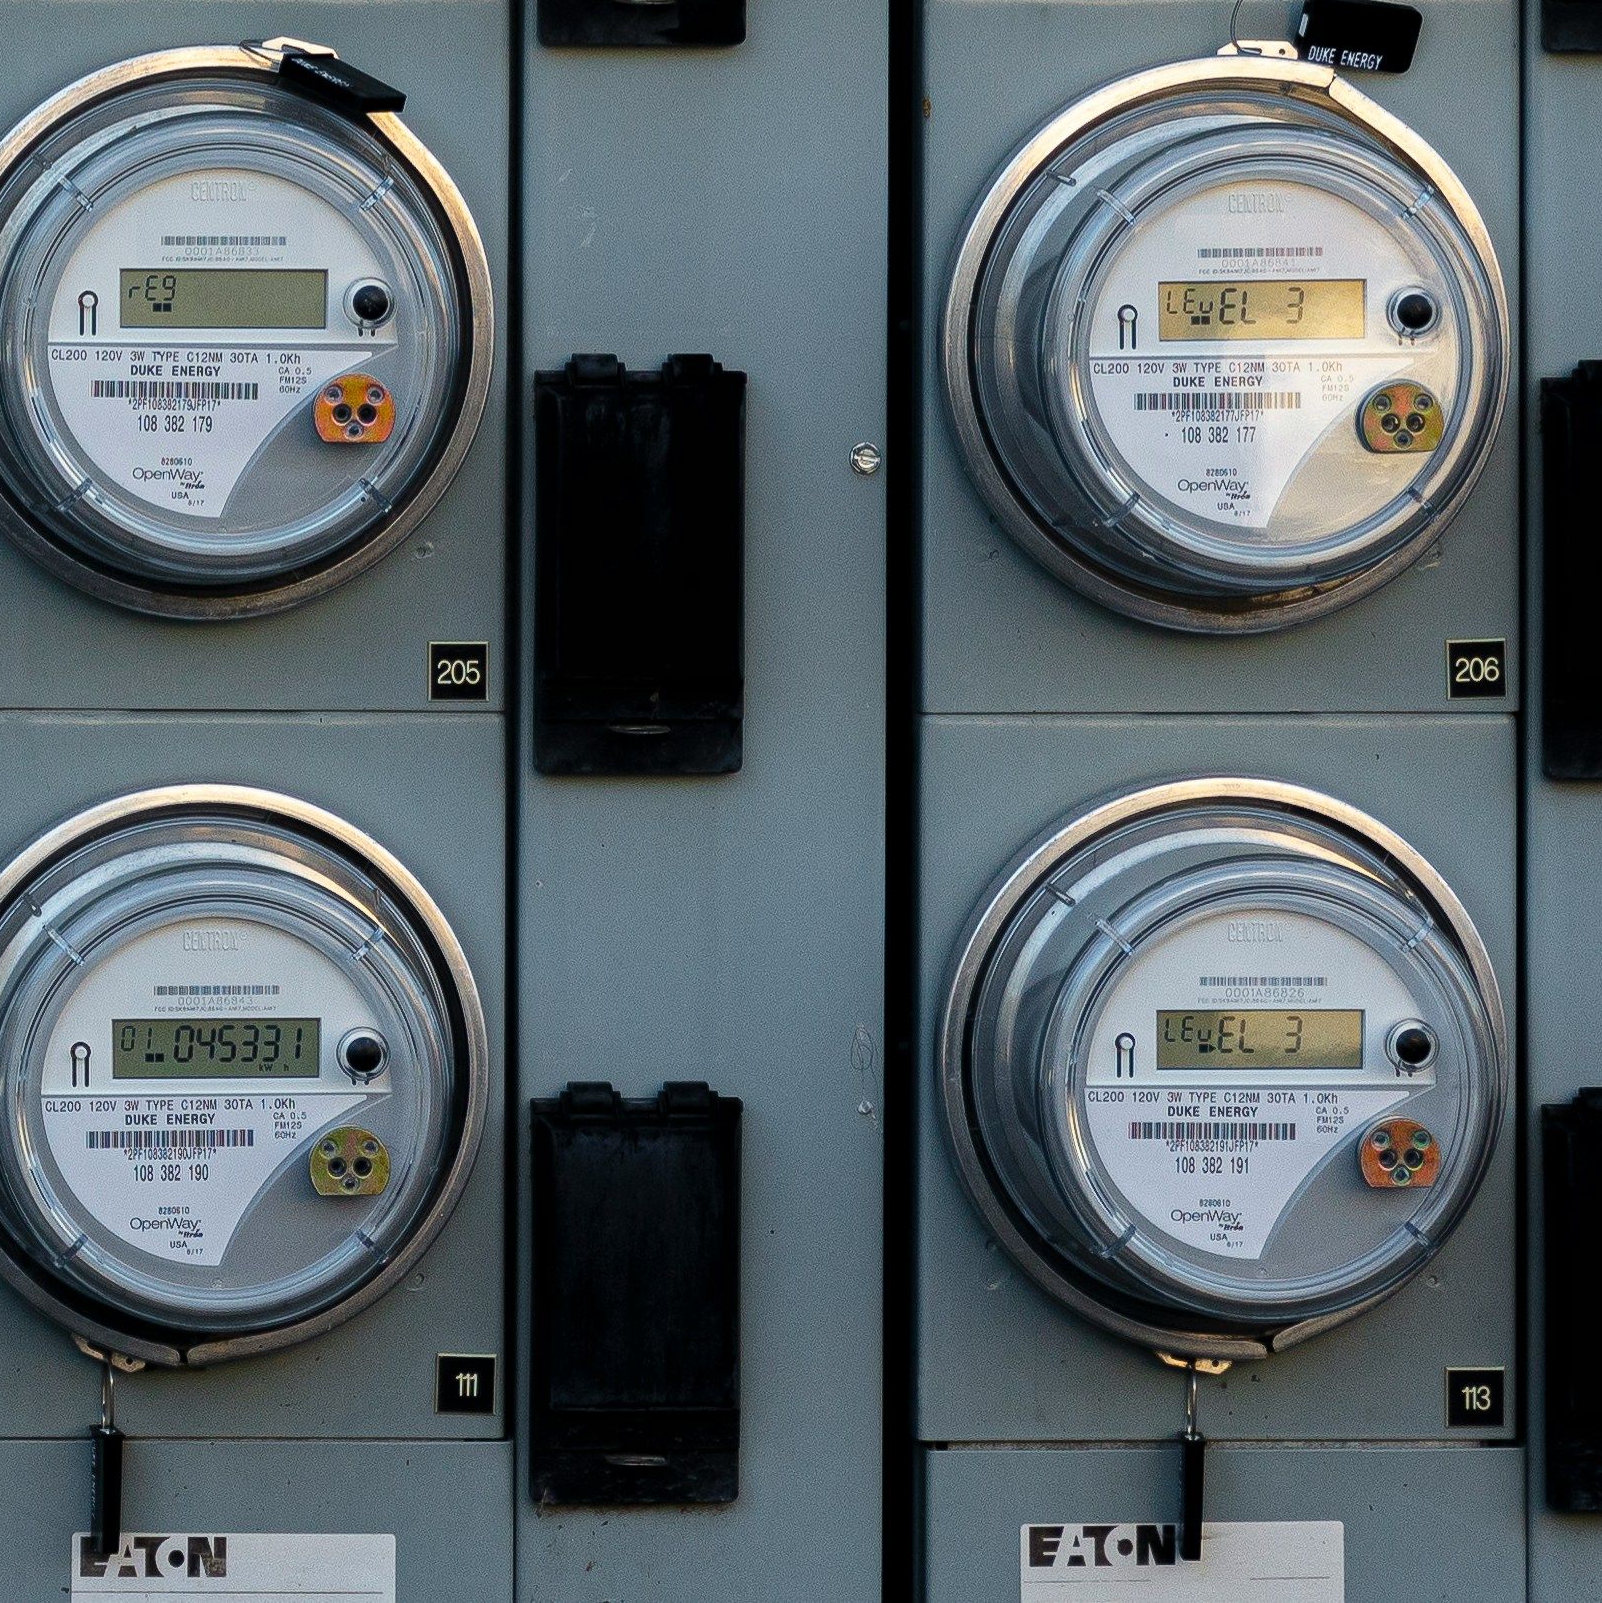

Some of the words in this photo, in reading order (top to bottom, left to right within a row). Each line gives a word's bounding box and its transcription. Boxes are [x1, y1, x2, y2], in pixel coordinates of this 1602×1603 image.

[1308, 46, 1336, 64] DUKE
[1340, 50, 1383, 70] ENERGY
[131, 365, 163, 376] DUKE
[171, 365, 221, 377] ENERGY
[1173, 377, 1205, 388] DUKE
[1214, 375, 1263, 387] ENERGY
[137, 416, 157, 432] 108
[164, 416, 185, 432] 382
[192, 416, 213, 433] 179
[1181, 428, 1201, 444] 108
[1208, 427, 1229, 444] 382
[1236, 427, 1257, 443] 177
[438, 660, 480, 684] 205
[1456, 657, 1499, 682] 206
[173, 1024, 302, 1063] 045331
[125, 1115, 157, 1126] DUKE
[166, 1114, 216, 1125] ENERGY
[1168, 1106, 1200, 1117] DUKE
[1209, 1106, 1258, 1117] ENERGY
[133, 1166, 153, 1182] 108
[160, 1165, 181, 1182] 382
[189, 1165, 209, 1181] 190
[1175, 1158, 1195, 1174] 108
[1202, 1158, 1223, 1174] 382
[1230, 1158, 1251, 1174] 191
[1169, 1210, 1239, 1224] OpenWay
[456, 1372, 477, 1397] 111
[1461, 1386, 1491, 1410] 113
[1029, 1524, 1176, 1567] EATON
